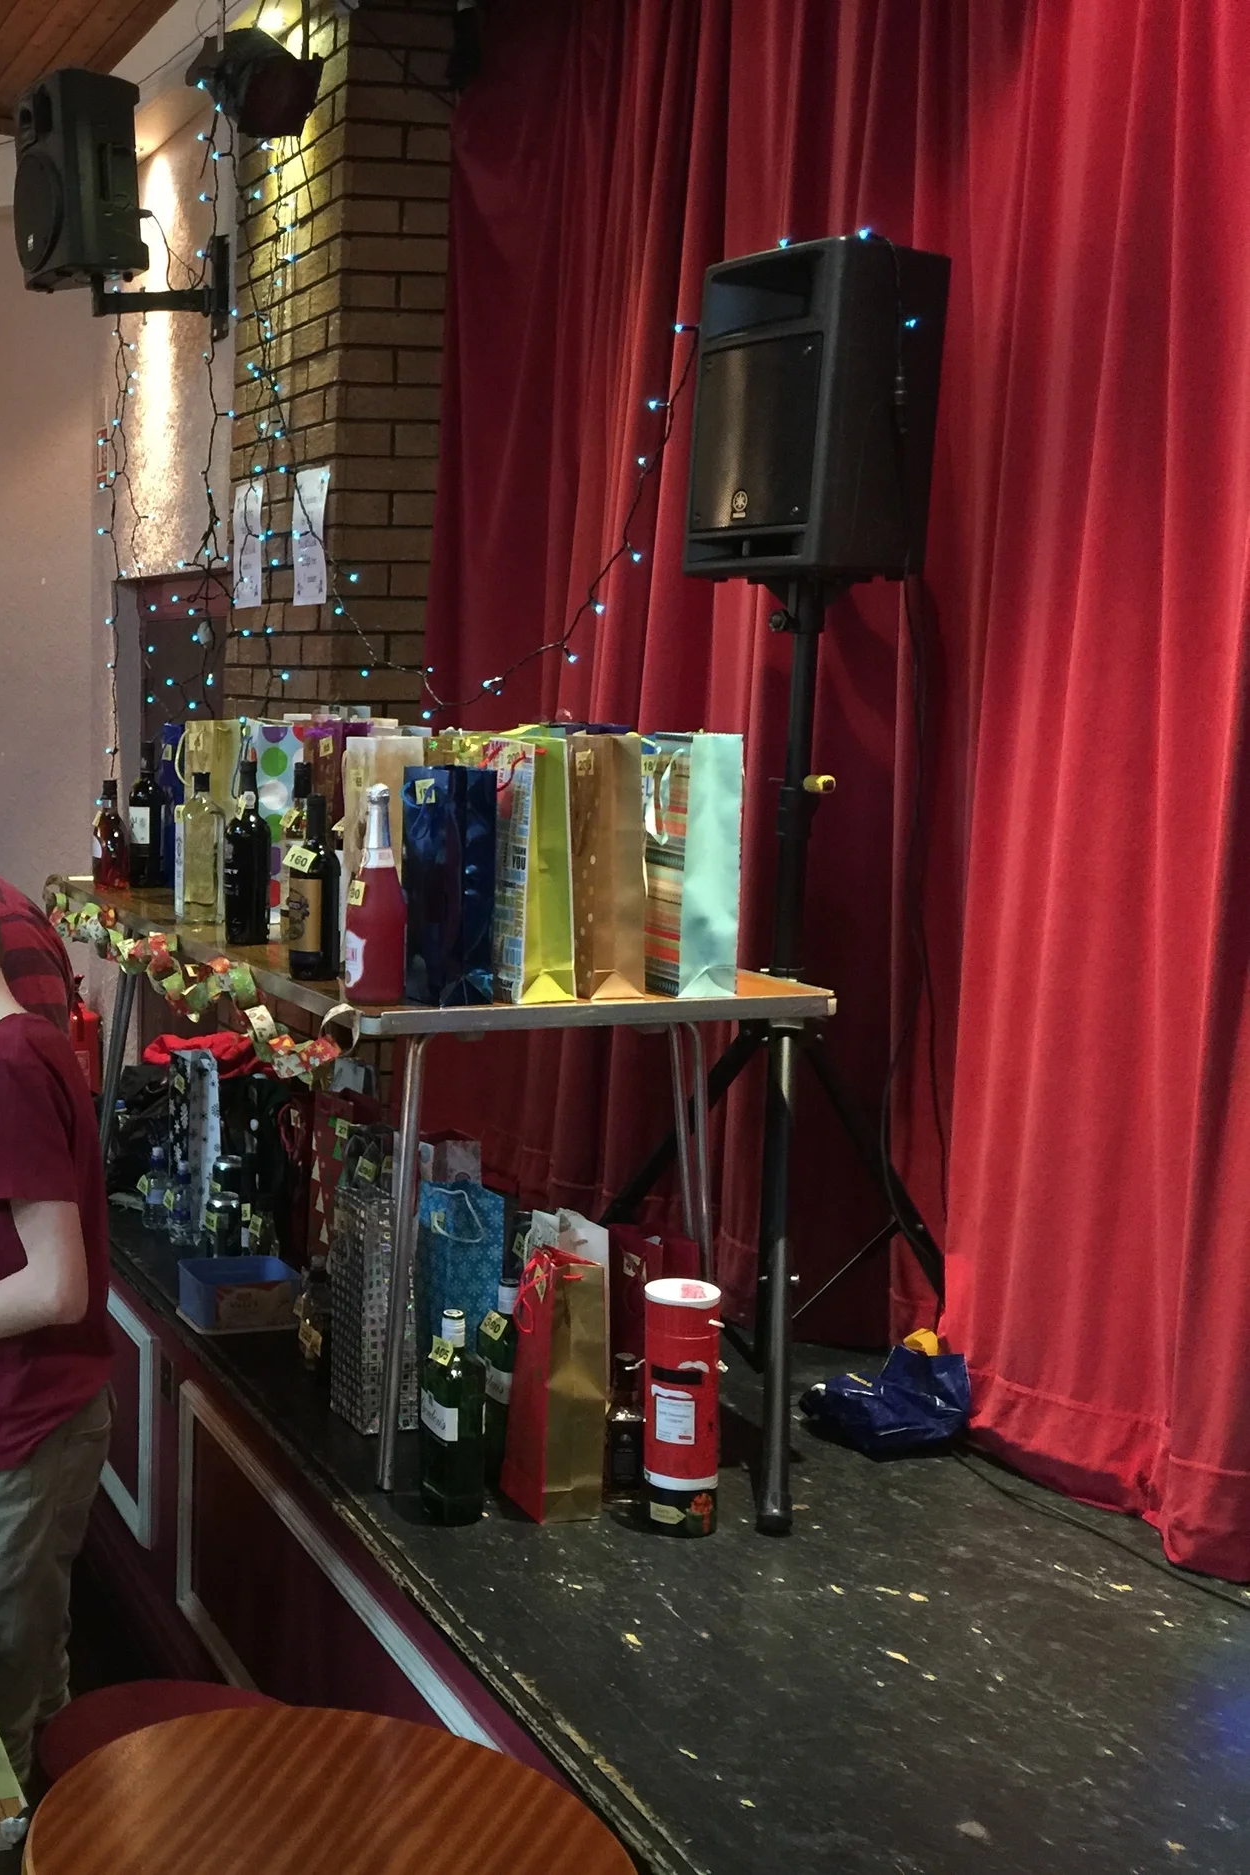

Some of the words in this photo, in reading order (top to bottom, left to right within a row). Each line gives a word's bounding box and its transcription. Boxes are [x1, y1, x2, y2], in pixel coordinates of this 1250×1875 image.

[289, 852, 308, 868] 160
[512, 856, 526, 870] YOU
[434, 1346, 450, 1361] 405
